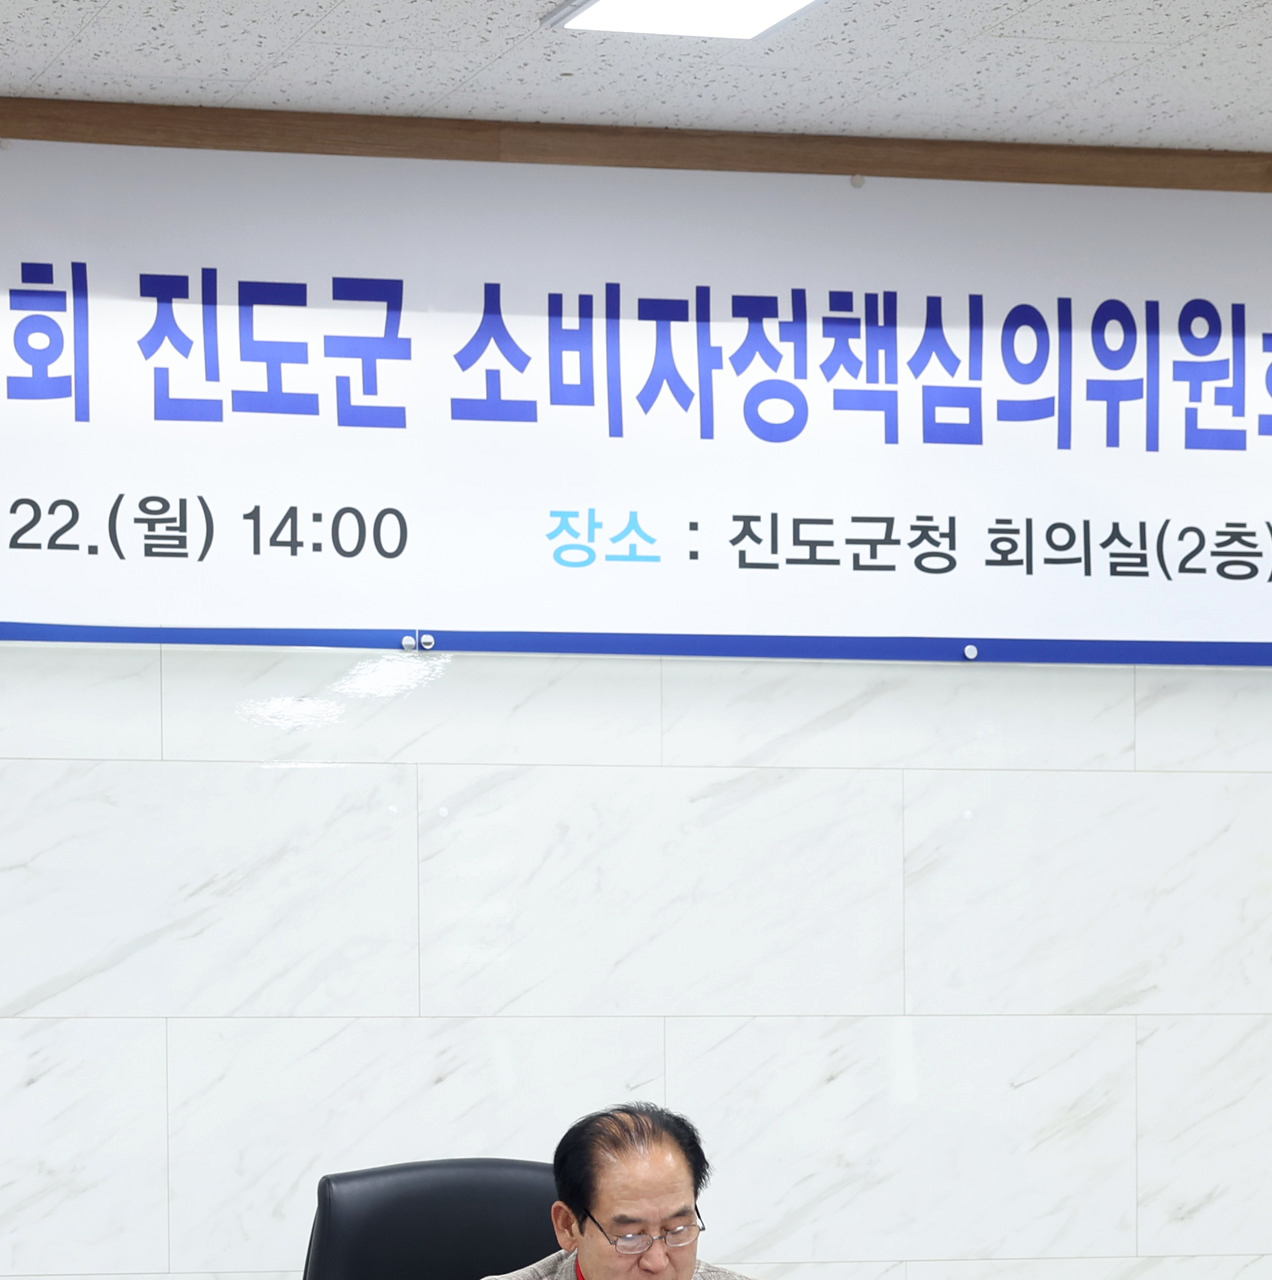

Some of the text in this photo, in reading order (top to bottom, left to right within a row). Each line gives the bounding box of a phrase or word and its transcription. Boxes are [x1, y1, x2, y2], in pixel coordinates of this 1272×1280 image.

[136, 267, 412, 429] 진도군
[8, 493, 215, 563] 22.(월)
[242, 504, 409, 559] 14:00
[544, 507, 662, 568] 장소
[728, 512, 959, 575] 진도군청
